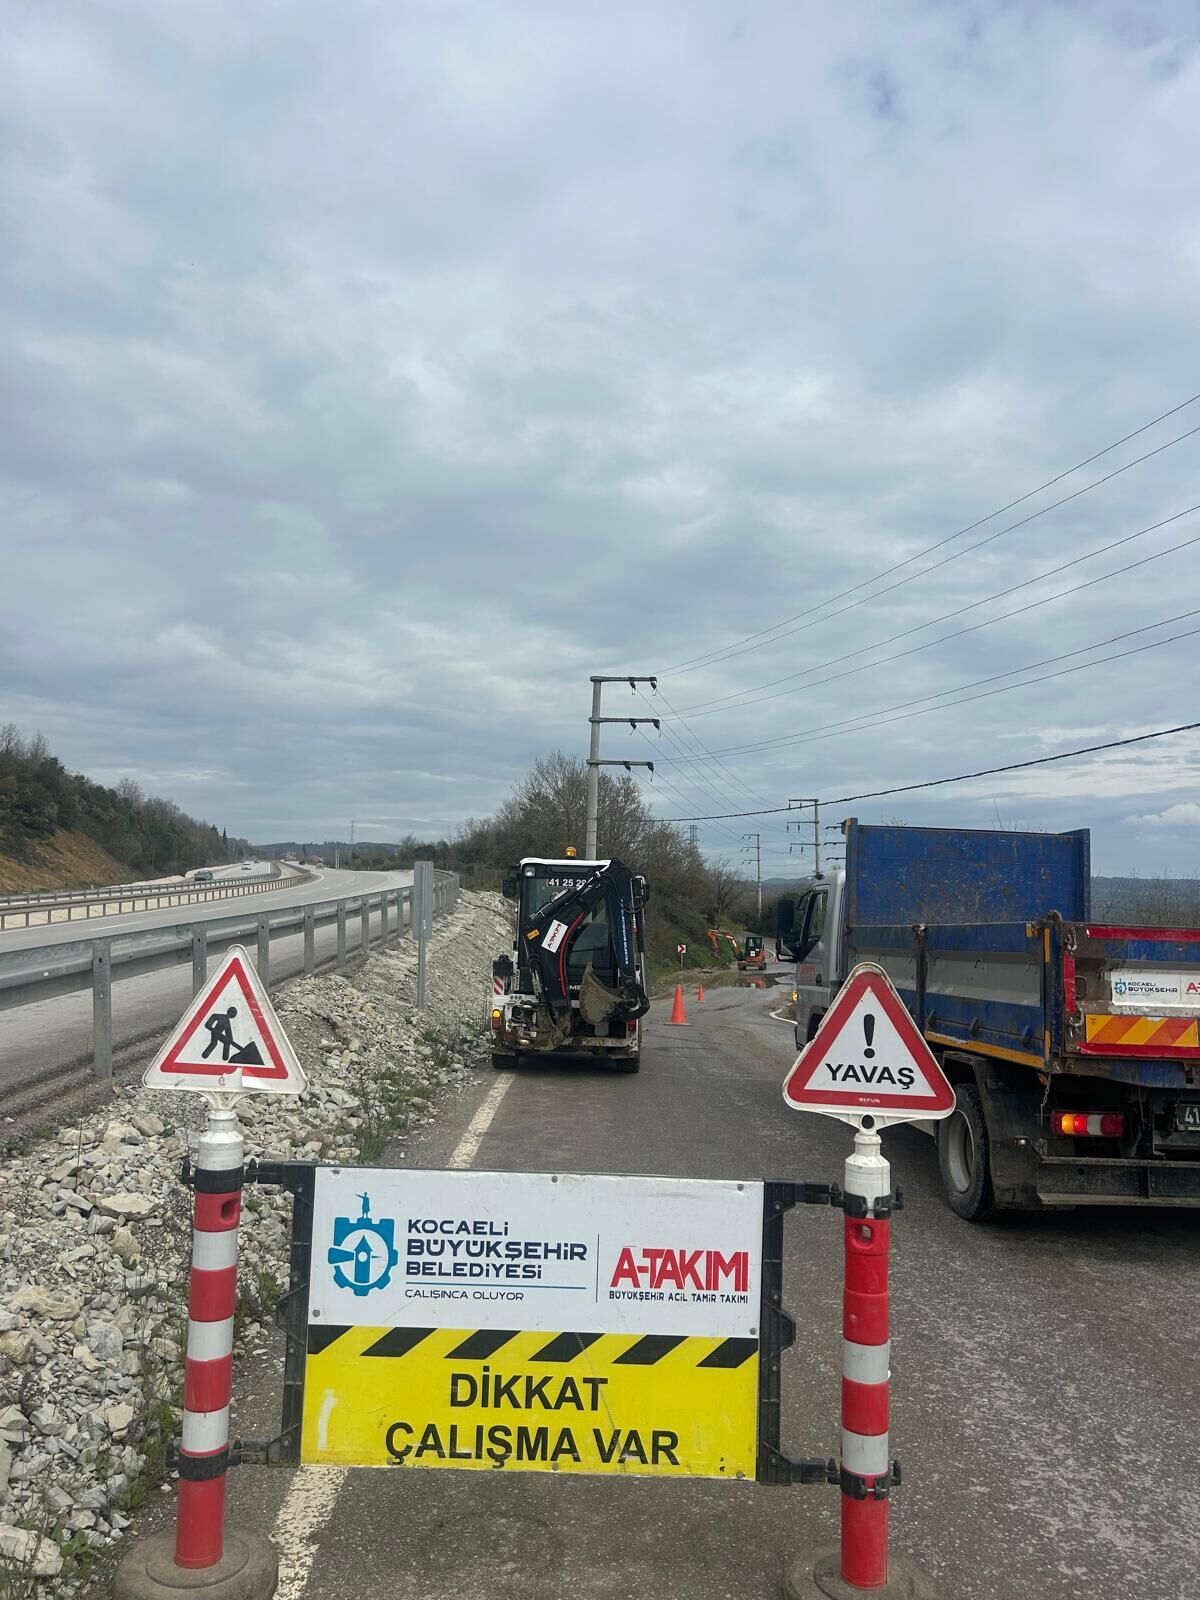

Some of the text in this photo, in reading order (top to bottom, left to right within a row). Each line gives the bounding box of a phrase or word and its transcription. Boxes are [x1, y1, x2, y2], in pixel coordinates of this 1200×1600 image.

[549, 878, 559, 887] 41
[562, 878, 574, 887] 25
[825, 1063, 915, 1090] YAVAŞ
[1184, 1106, 1200, 1124] 41
[610, 1247, 749, 1292] A-TAKIMI
[405, 1289, 525, 1301] ÇALIŞINCA OLUYOR
[720, 1294, 748, 1304] TAKIMI
[449, 1365, 609, 1411] DİKKAT
[385, 1421, 681, 1469] ÇALIŞMA VAR
